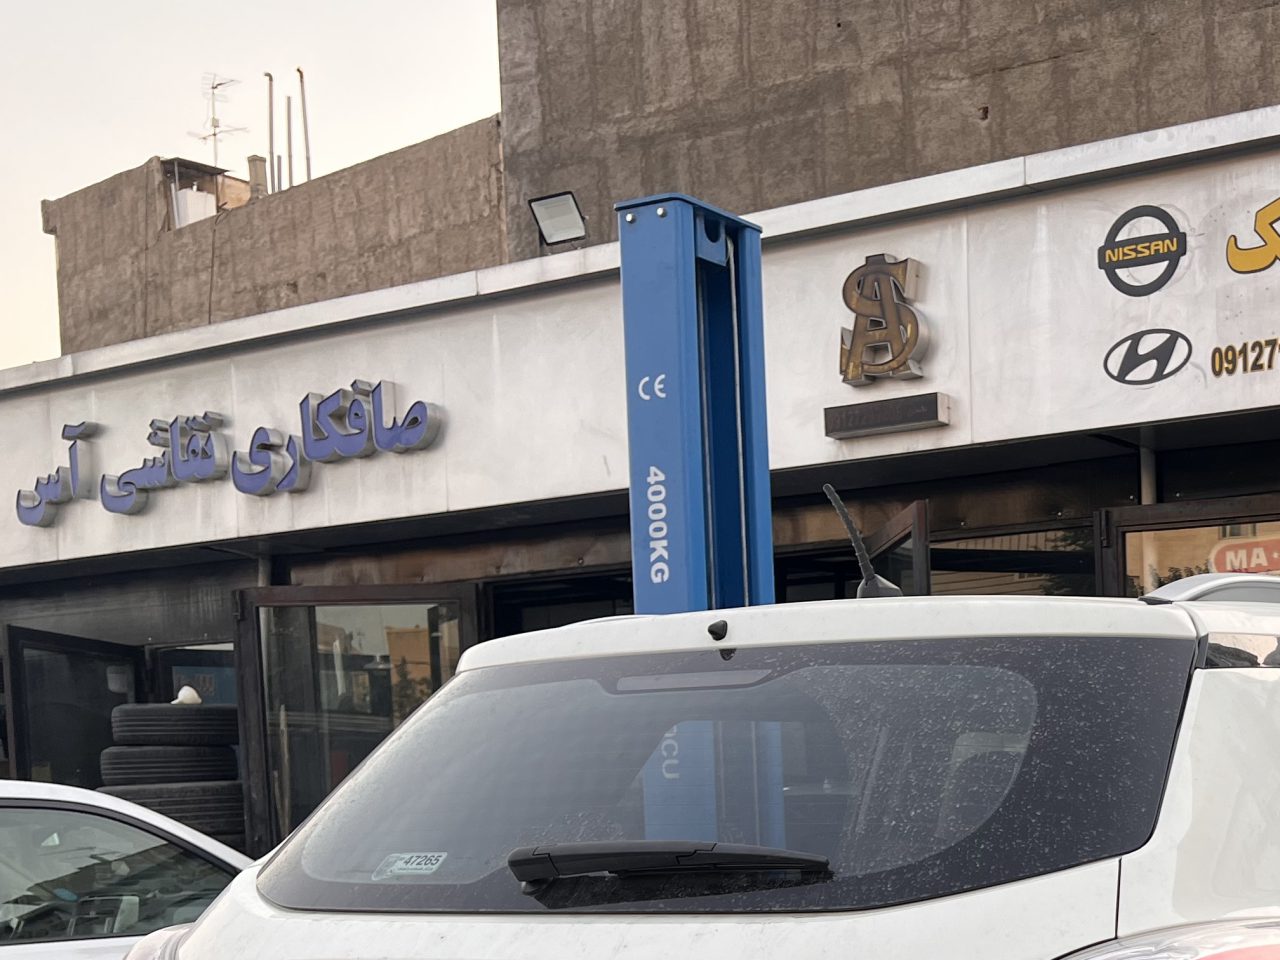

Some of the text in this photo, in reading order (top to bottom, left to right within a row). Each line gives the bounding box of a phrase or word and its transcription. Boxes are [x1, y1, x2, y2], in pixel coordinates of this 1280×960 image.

[1105, 237, 1178, 263] NISSAN
[16, 379, 438, 527] صافکاری نقاشی آس
[647, 466, 670, 584] 4000KG
